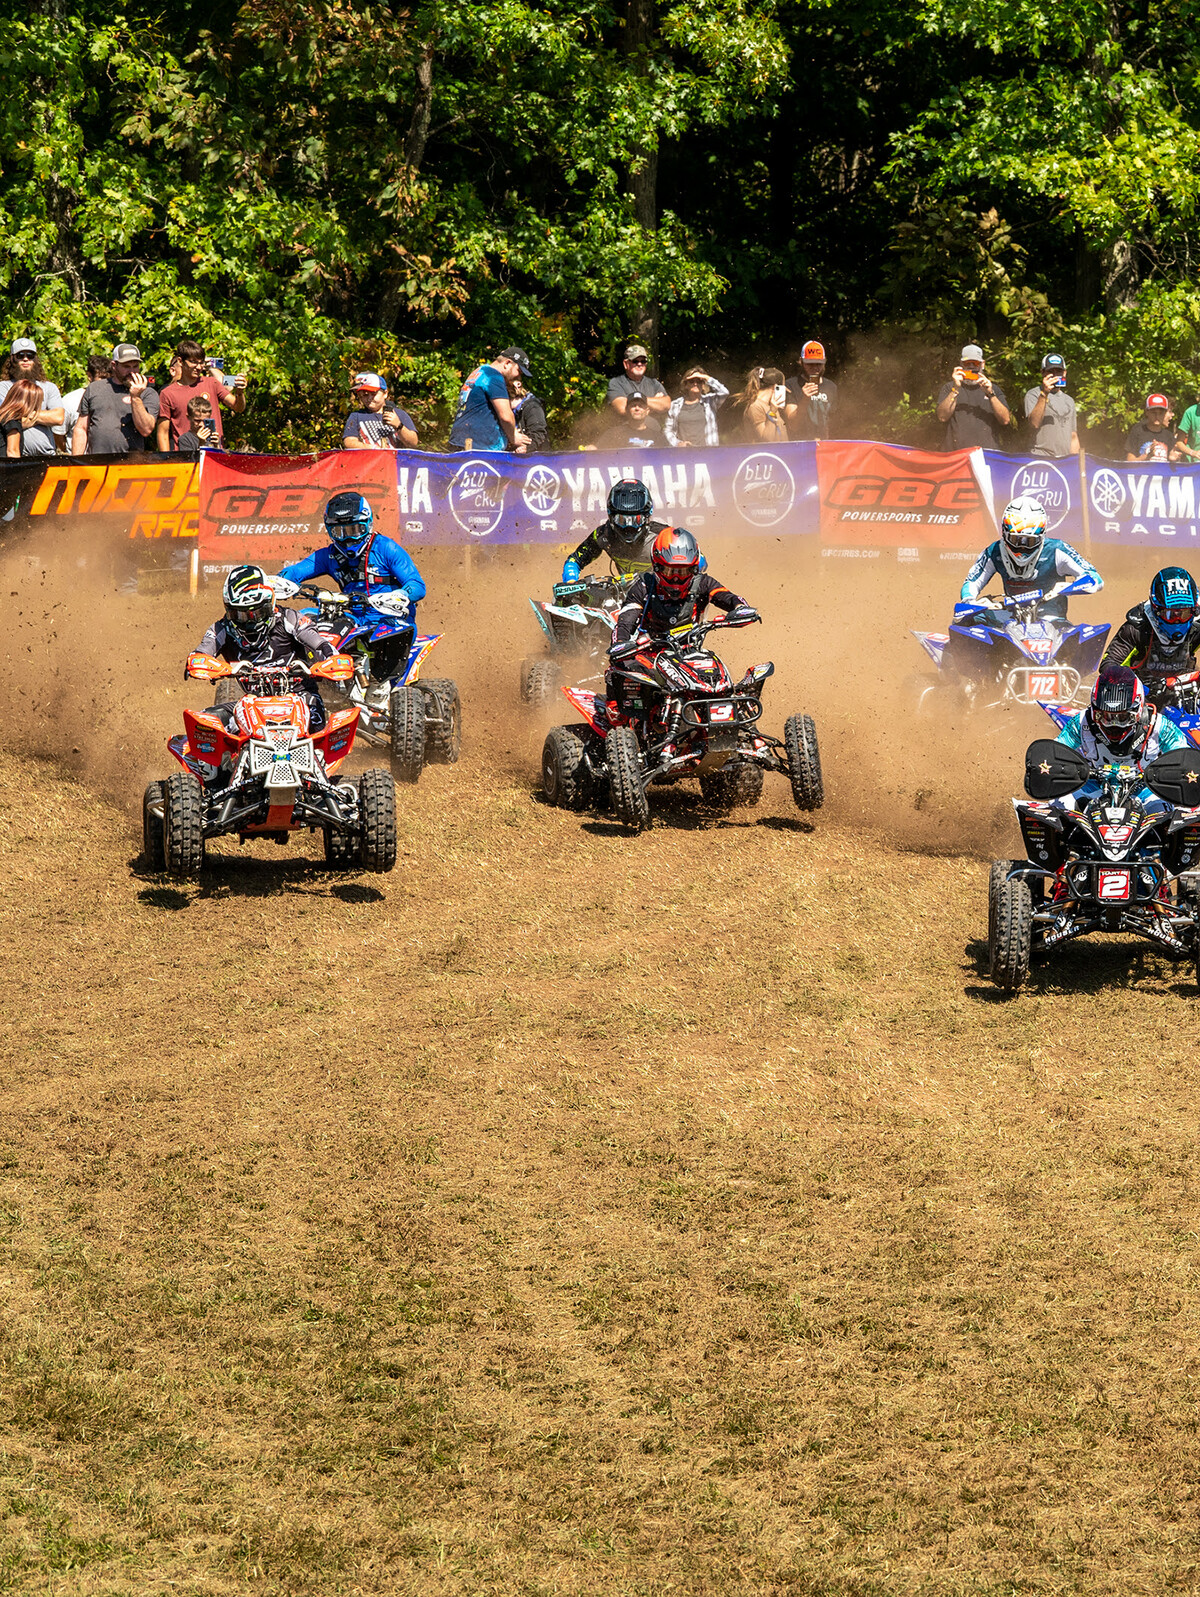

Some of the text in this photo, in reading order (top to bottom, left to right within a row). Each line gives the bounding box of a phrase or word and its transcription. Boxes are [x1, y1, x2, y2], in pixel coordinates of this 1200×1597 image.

[1022, 470, 1049, 488] bLU
[841, 511, 923, 524] POWERSPORTS
[927, 514, 960, 525] TIRES
[220, 523, 309, 534] POWERSPORTS
[1157, 579, 1179, 592] FLY
[1031, 677, 1056, 696] 712
[710, 705, 734, 721] 3
[1101, 876, 1128, 897] 2
